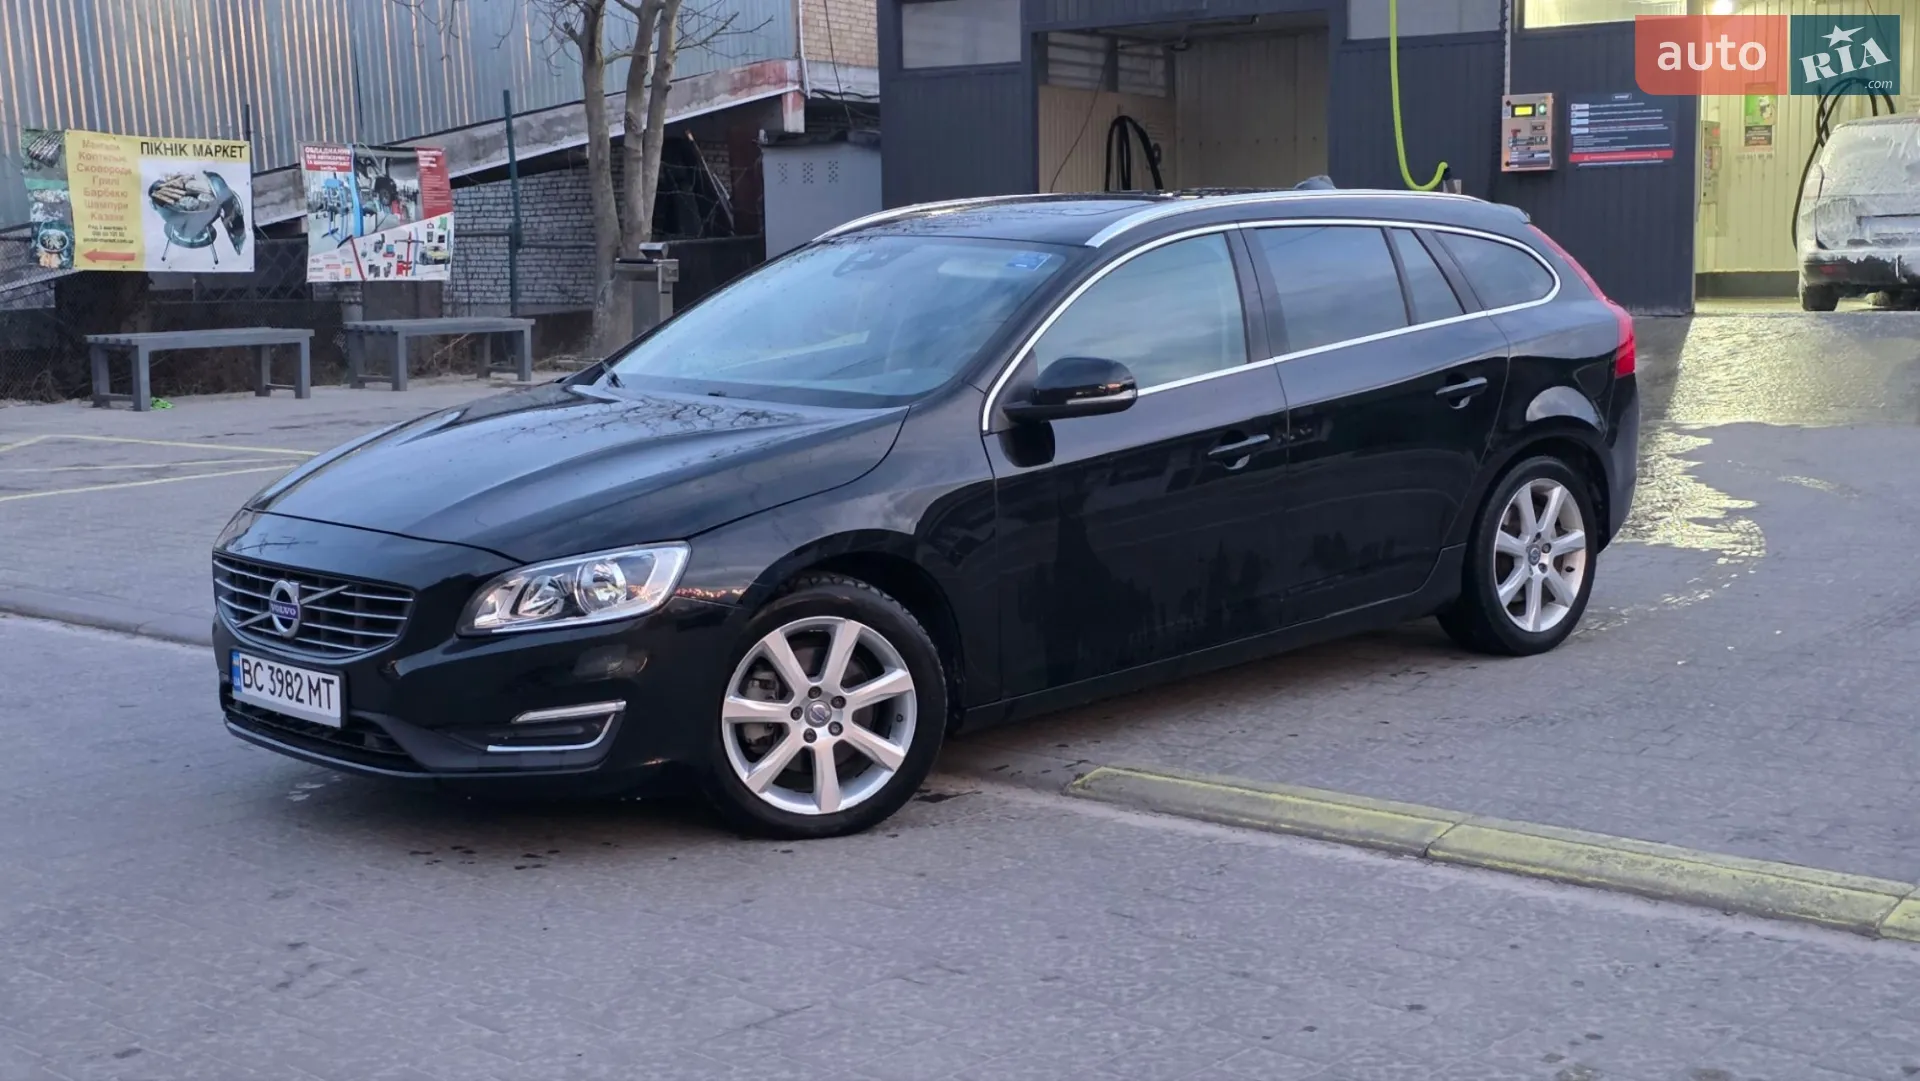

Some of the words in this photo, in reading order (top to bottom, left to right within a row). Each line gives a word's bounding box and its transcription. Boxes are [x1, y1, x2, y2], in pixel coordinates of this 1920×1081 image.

[140, 141, 189, 157] ПІКНІК
[193, 143, 246, 159] МАРКЕТ
[83, 187, 129, 198] Барбекю
[271, 603, 297, 616] VOLVO
[241, 658, 264, 692] BC
[267, 665, 305, 705] 3982
[307, 675, 335, 710] MT
